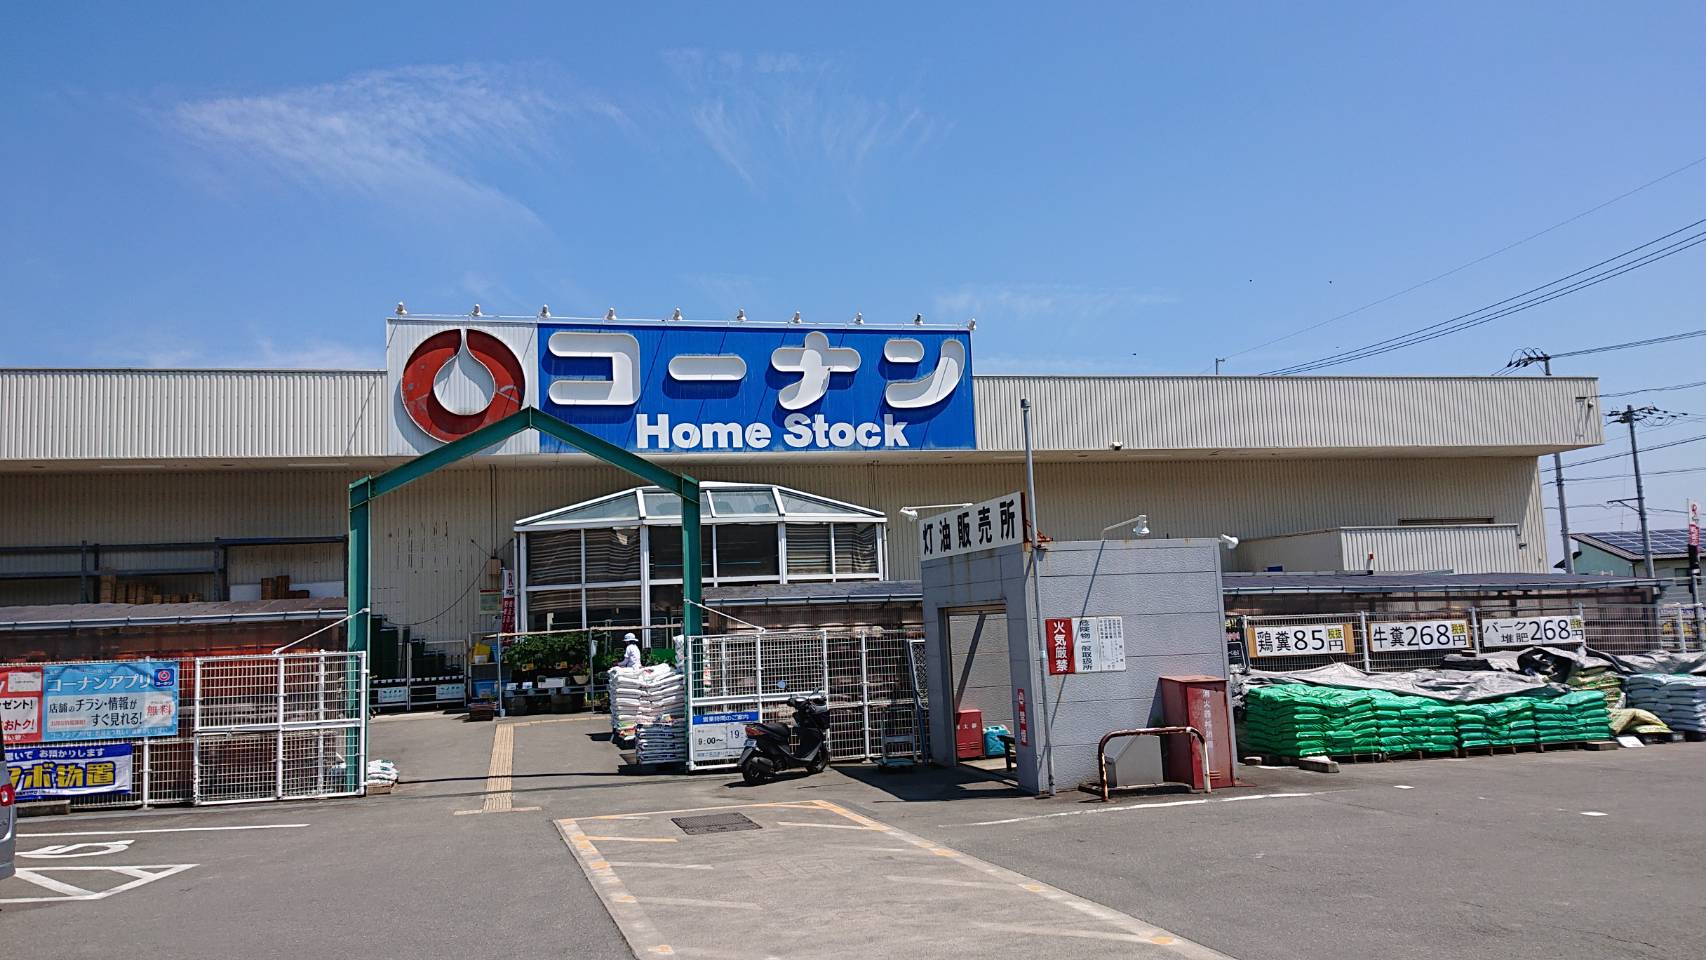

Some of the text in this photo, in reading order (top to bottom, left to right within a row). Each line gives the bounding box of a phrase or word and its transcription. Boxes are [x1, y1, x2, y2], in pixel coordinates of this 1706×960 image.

[548, 331, 967, 410] コーナン
[635, 412, 911, 449] Home Stock
[922, 498, 1016, 556] 灯油販売所
[1484, 620, 1528, 634] バーク
[1053, 620, 1068, 672] 火気厳禁
[1500, 632, 1530, 644] 堆肥
[47, 673, 151, 692] コーナンアプリ
[0, 699, 33, 710] ゼント!
[48, 696, 138, 714] 店舗のチラシ・情報が
[146, 704, 172, 717] 無料
